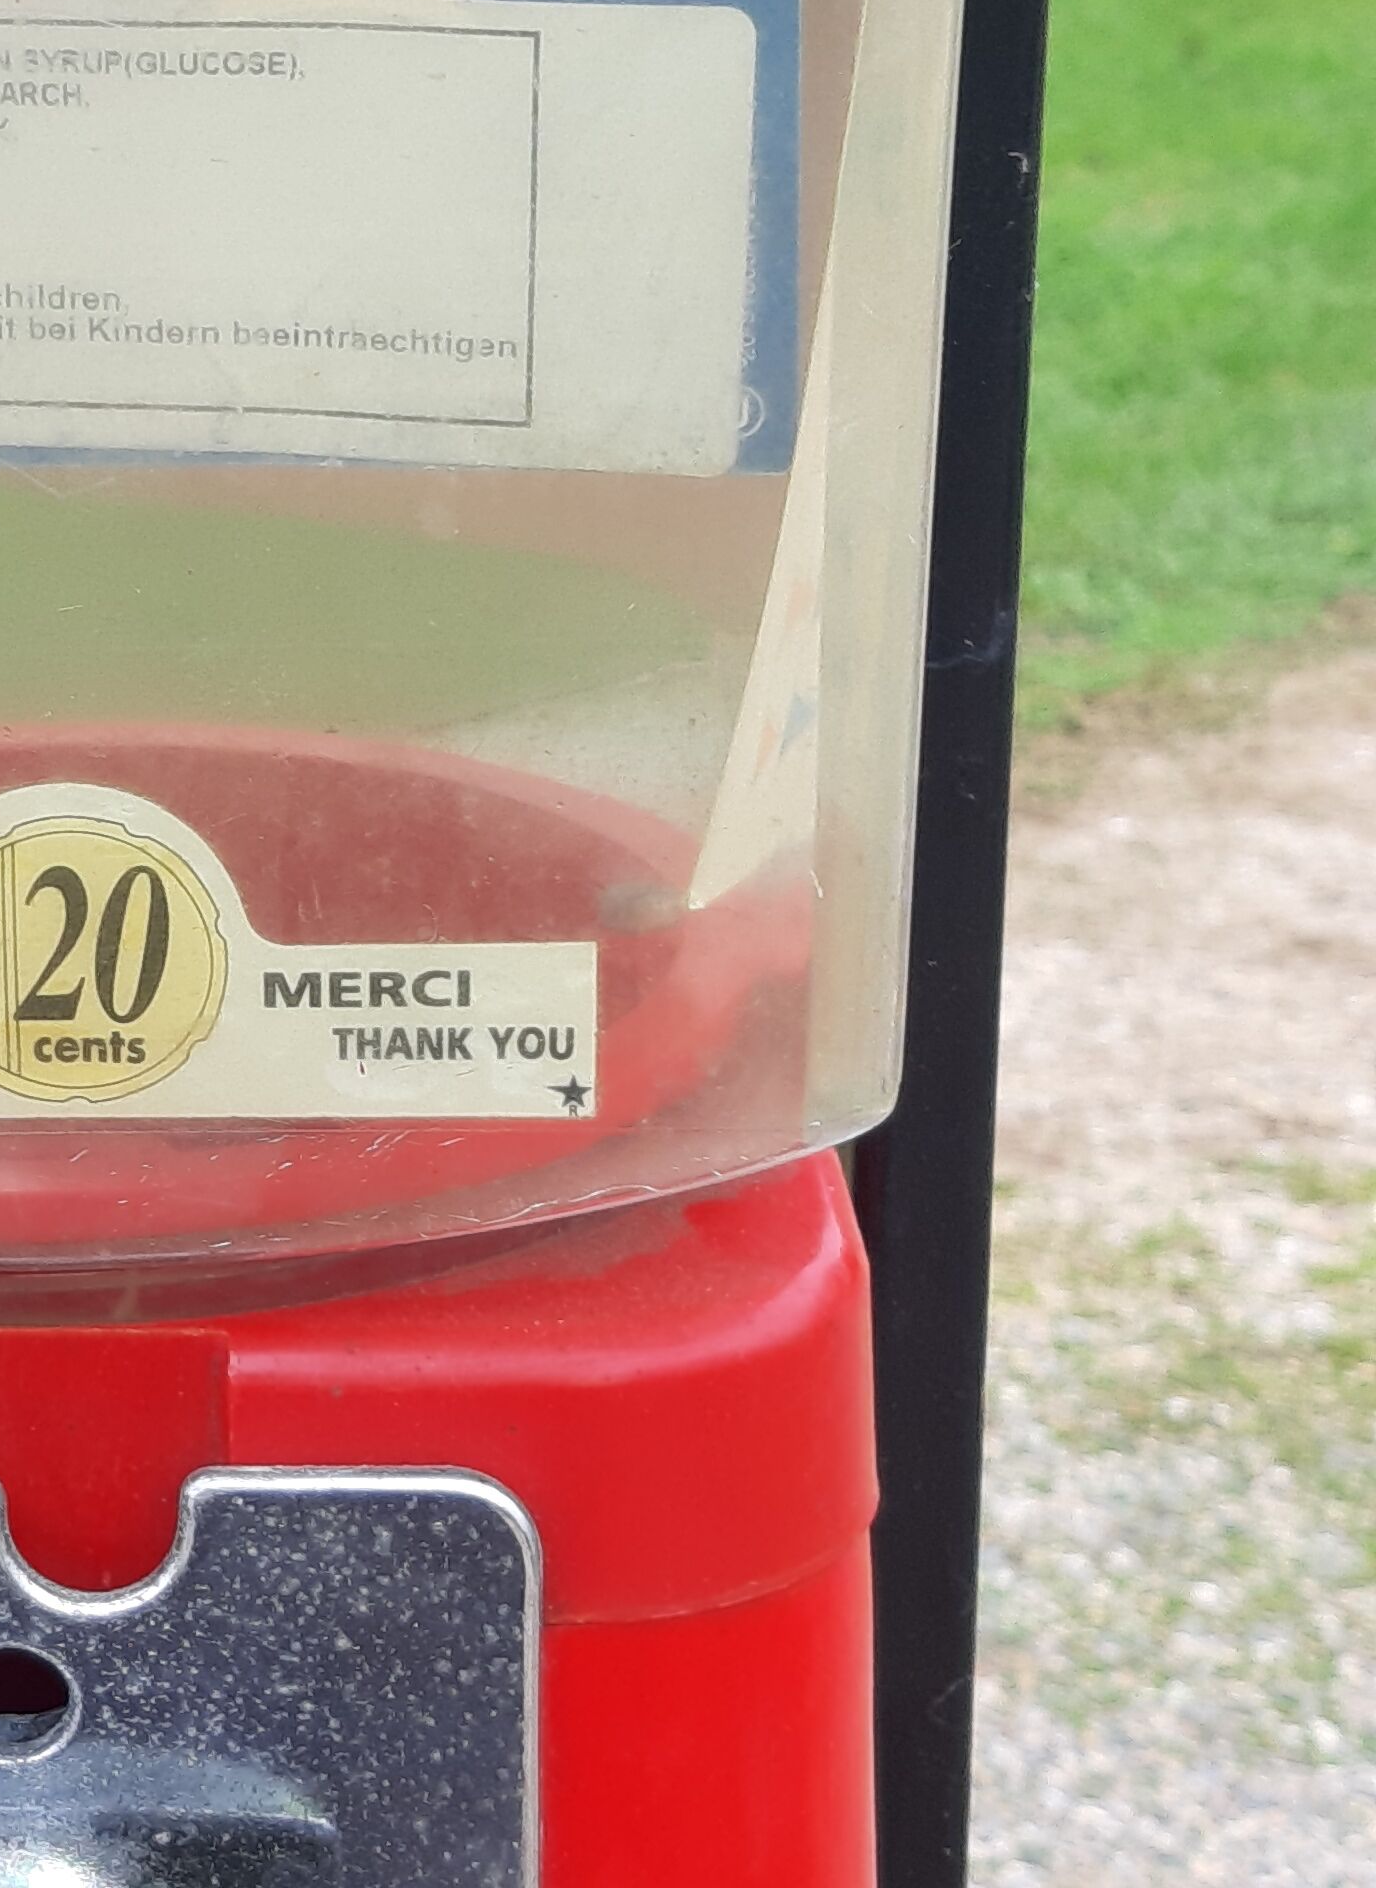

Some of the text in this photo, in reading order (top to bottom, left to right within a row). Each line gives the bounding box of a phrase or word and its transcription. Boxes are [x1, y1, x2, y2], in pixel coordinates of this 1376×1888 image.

[29, 315, 77, 342] bei
[88, 316, 221, 345] Kindern
[233, 320, 518, 363] beeintraechtigen
[13, 864, 171, 1025] 20
[261, 970, 472, 1011] MERCI
[33, 1030, 147, 1067] cents
[332, 1026, 576, 1064] THANK YOU
